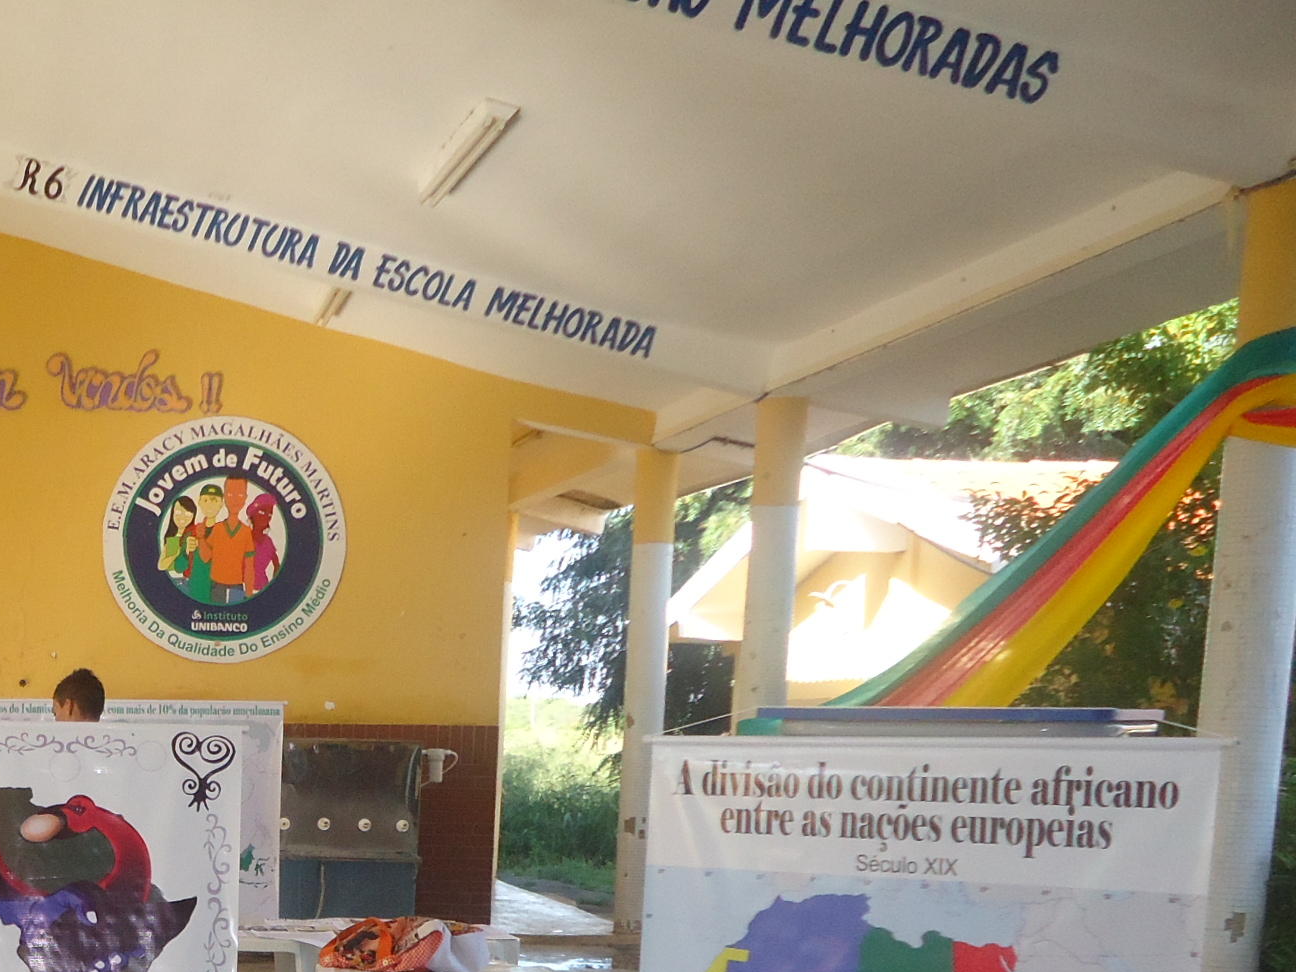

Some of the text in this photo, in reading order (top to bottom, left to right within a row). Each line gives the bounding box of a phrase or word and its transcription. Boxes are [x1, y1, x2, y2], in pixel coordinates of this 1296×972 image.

[734, 0, 1060, 104] MELHORADAS
[77, 173, 321, 270] INFRAESTRUTURA
[327, 240, 362, 281] DA
[372, 253, 477, 312] ESCOLA
[483, 286, 658, 360] MELHORADA
[107, 421, 341, 542] E.E.M. ARACY MAGALHÃES MARTINS
[135, 446, 308, 520] Jovem de Futuro
[112, 569, 332, 658] Melhoria Da Qualidade Do Ensino Médio
[190, 621, 249, 633] UNIBANCO
[203, 611, 249, 622] Instituto
[9, 703, 20, 714] do
[107, 703, 281, 719] com mais de 10% da população muçulmana
[672, 758, 1180, 811] A divisão do continente africano
[720, 802, 1114, 859] entre as nações europeias
[855, 853, 958, 877] Século XIX
